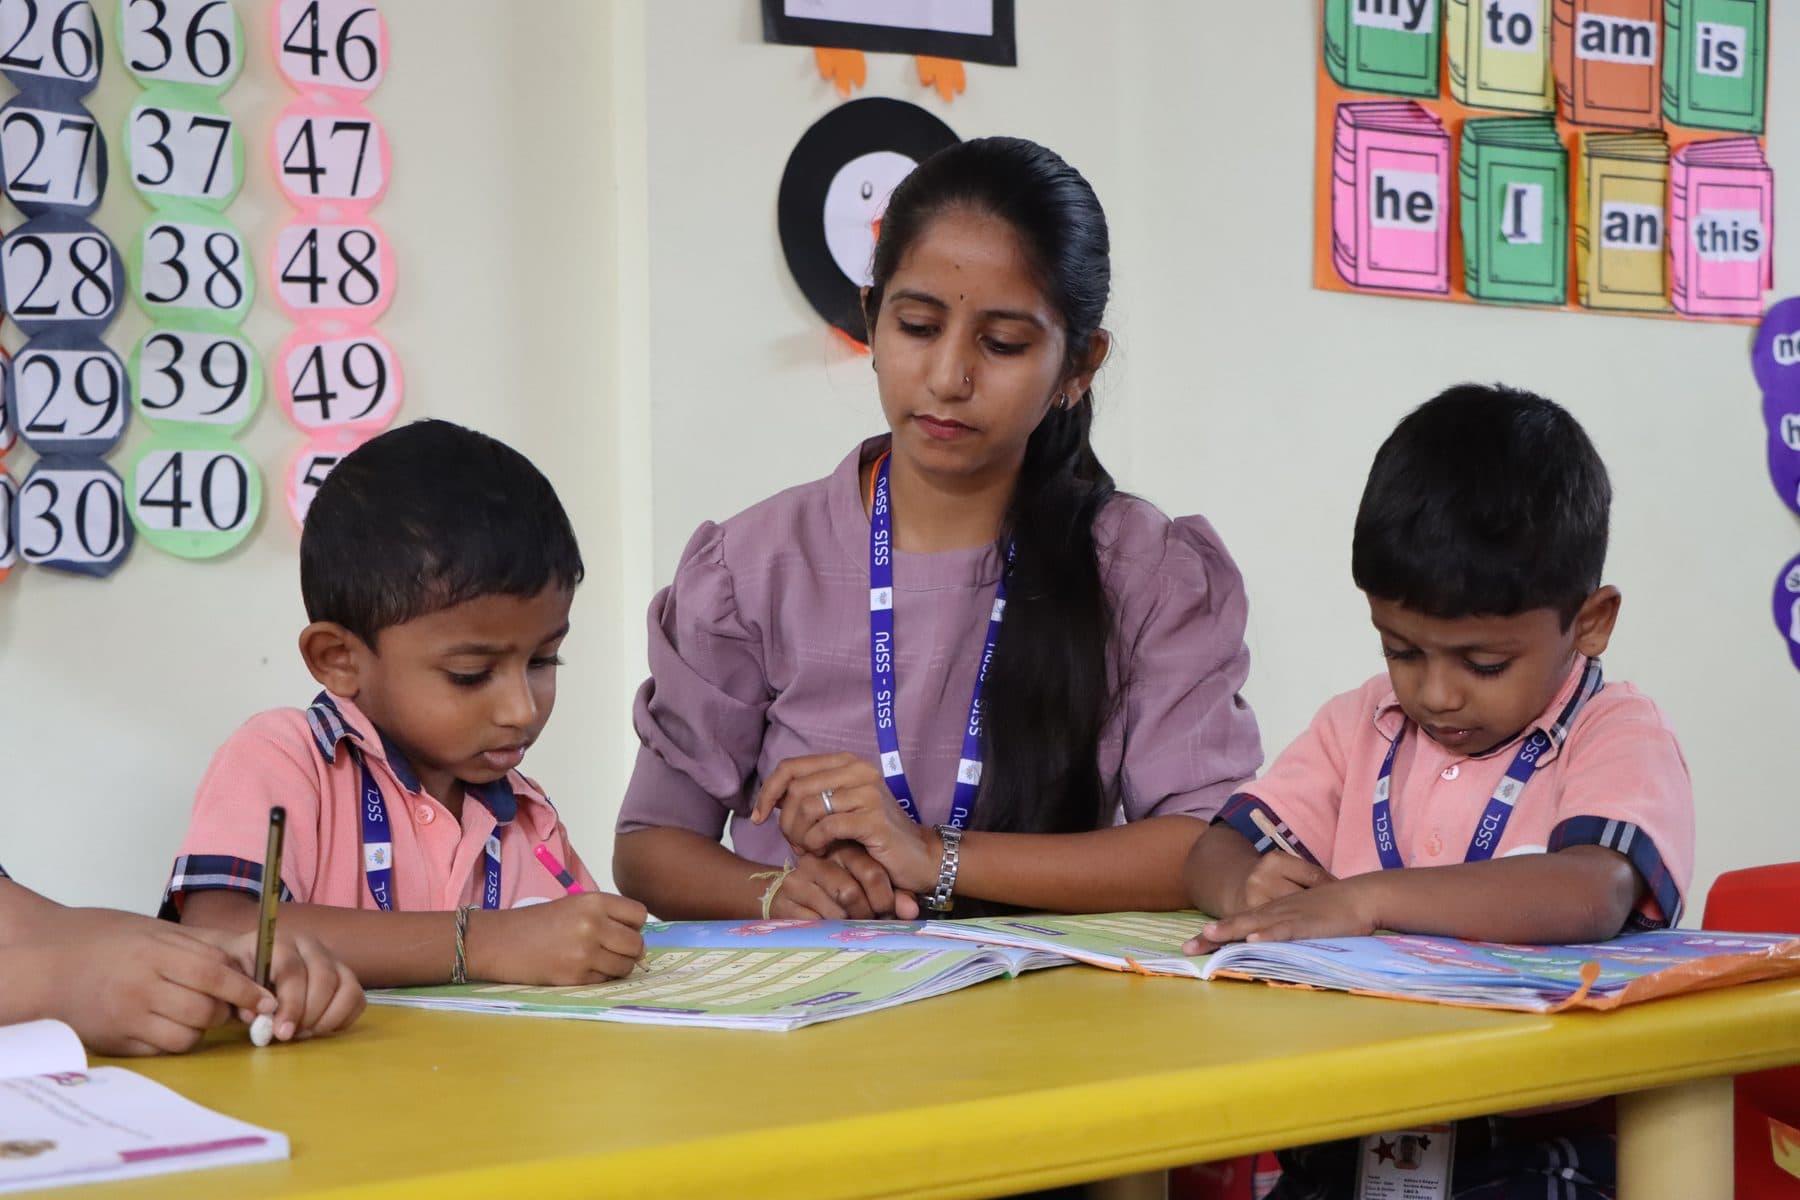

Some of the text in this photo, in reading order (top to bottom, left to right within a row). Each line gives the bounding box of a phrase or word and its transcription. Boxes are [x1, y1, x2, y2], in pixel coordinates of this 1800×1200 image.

[0, 0, 93, 78] 26
[129, 0, 231, 77] 36
[283, 0, 378, 82] 46
[1488, 6, 1532, 45] to
[1580, 20, 1652, 57] am
[1701, 28, 1739, 72] is
[2, 112, 95, 199] 27
[136, 108, 232, 193] 37
[283, 119, 371, 196] 47
[1375, 176, 1433, 223] he
[1604, 211, 1658, 245] an
[144, 225, 243, 310] 38
[281, 228, 379, 305] 48
[1696, 221, 1759, 253] this
[8, 235, 113, 317] 28
[22, 354, 120, 436] 29
[141, 333, 248, 415] 39
[292, 342, 386, 420] 49
[23, 477, 120, 558] 30
[139, 452, 248, 530] 40
[876, 477, 887, 515] SSPU
[875, 529, 889, 566] SSIS
[876, 632, 890, 673] SSPU
[878, 691, 892, 729] SSIS
[368, 788, 383, 822] SSCL
[1376, 811, 1392, 851] SSCL
[1475, 812, 1502, 850] SSCL
[487, 871, 498, 906] SSCL
